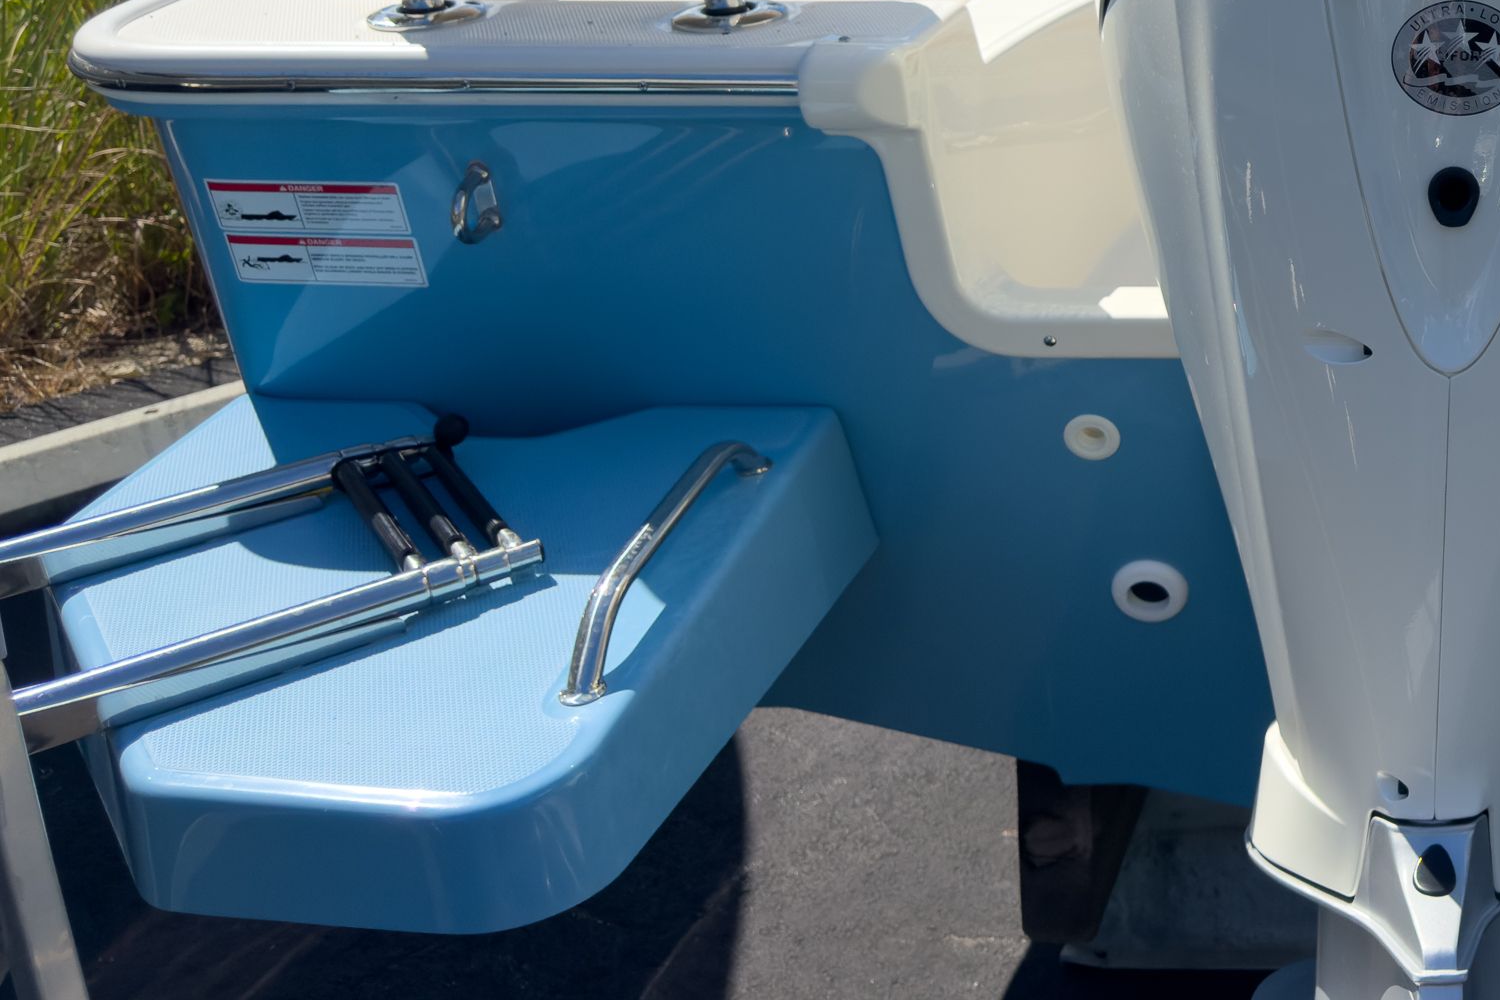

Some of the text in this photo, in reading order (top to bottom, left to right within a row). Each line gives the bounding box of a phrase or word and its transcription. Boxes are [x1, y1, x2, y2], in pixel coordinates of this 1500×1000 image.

[1410, 4, 1465, 32] ULTRA
[287, 184, 324, 193] DANGER
[306, 238, 342, 247] DANGER
